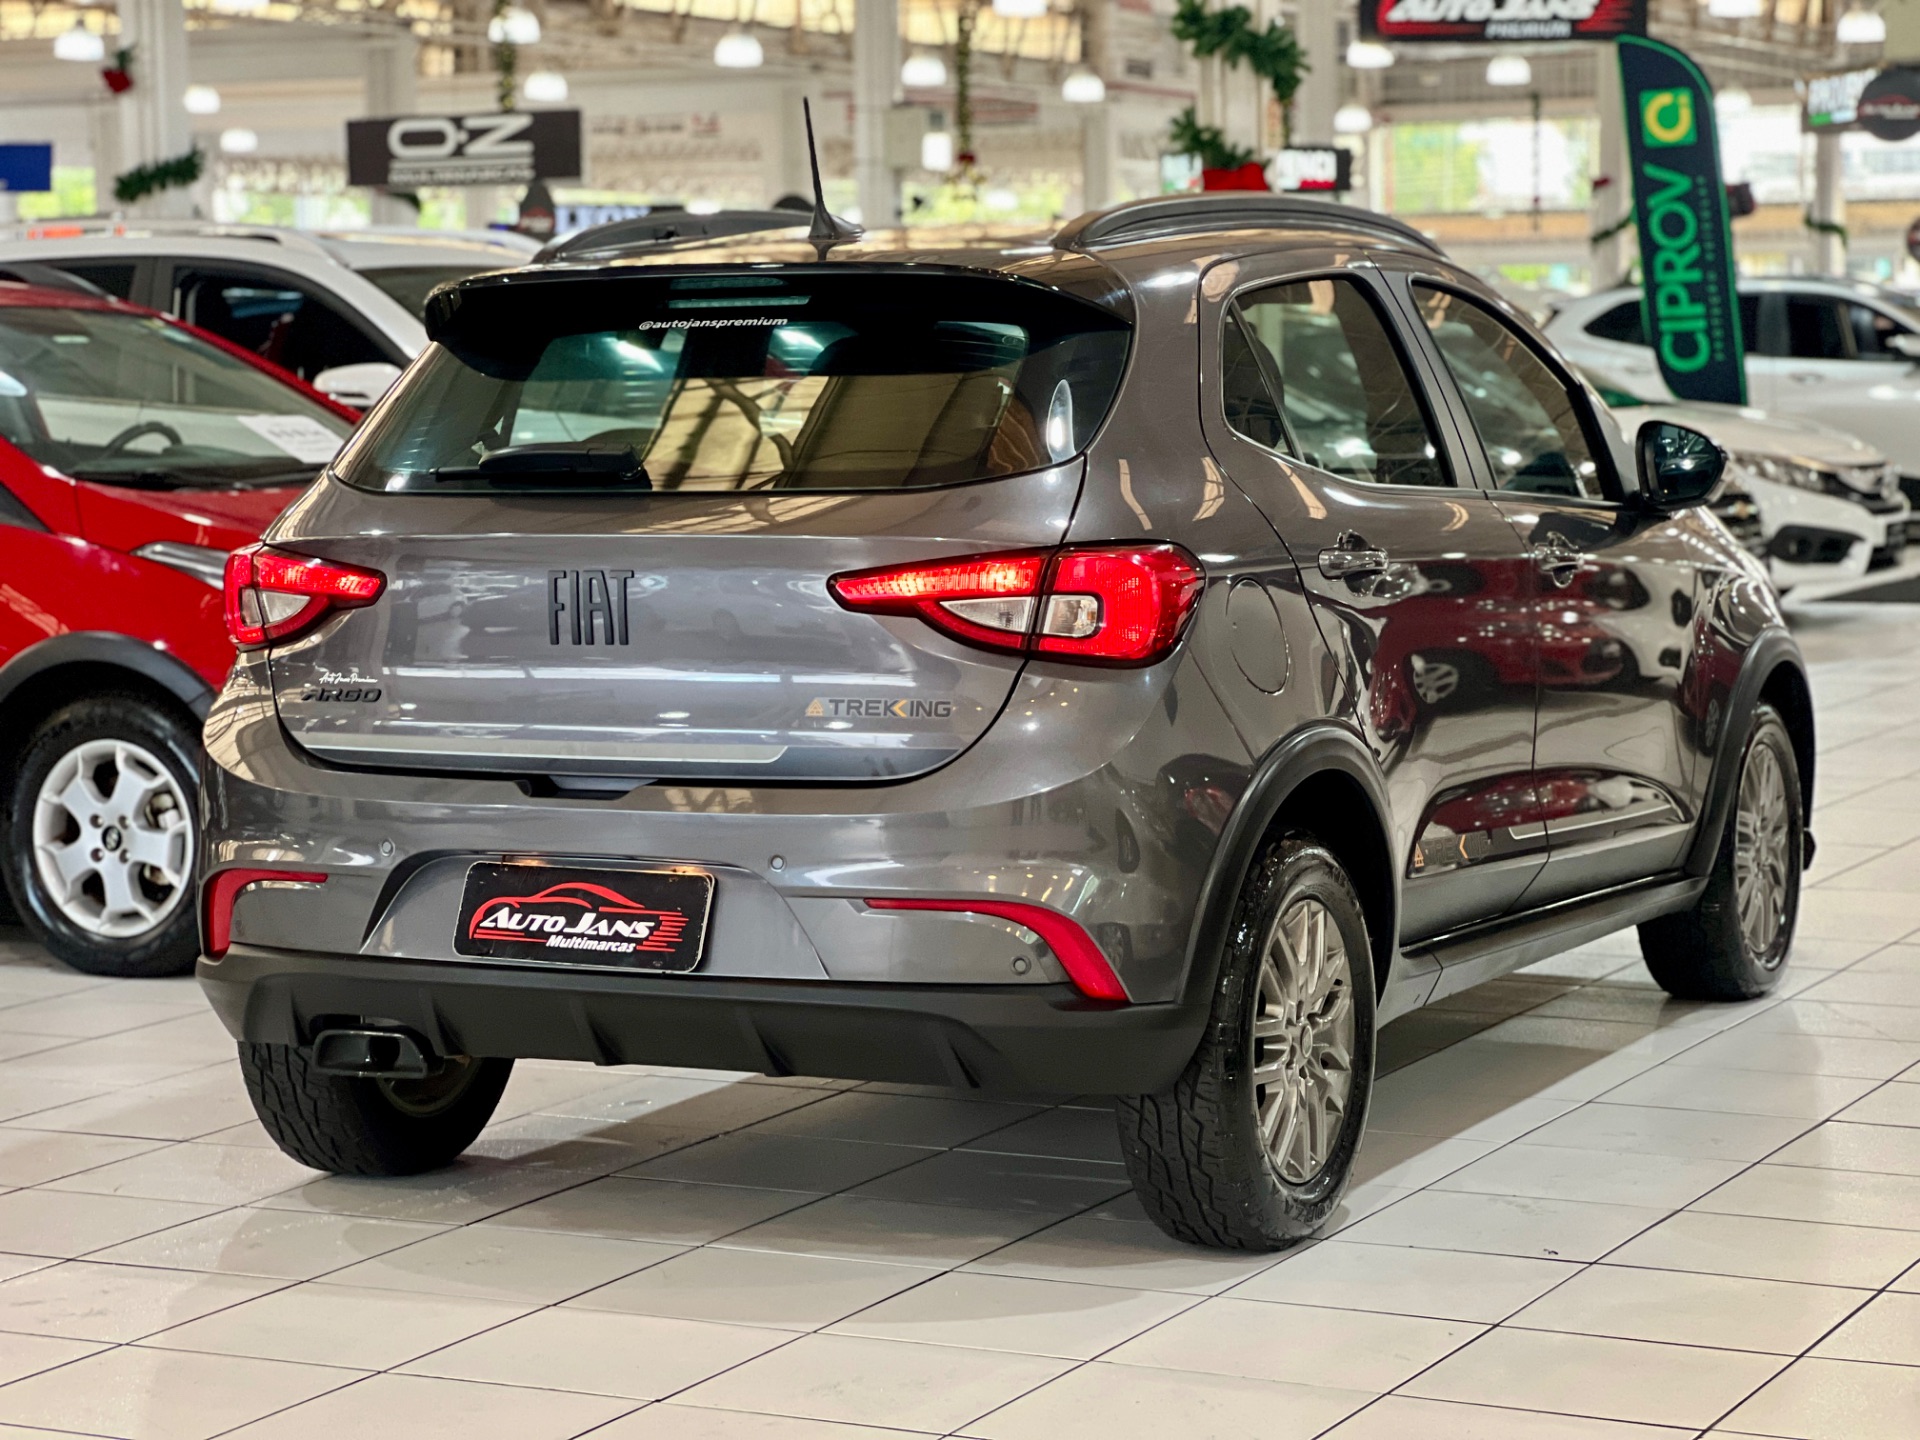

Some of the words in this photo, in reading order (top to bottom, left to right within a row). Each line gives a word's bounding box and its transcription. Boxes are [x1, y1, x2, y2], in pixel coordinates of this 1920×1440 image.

[1484, 21, 1572, 39] PREMIUM
[1642, 162, 1711, 373] CIPROV
[639, 317, 788, 331] @autojanspremium
[548, 570, 634, 645] FIAT
[301, 688, 382, 702] ARGO
[479, 907, 566, 932] AUTO
[569, 912, 655, 938] JANS
[546, 935, 637, 953] Multimarcas
